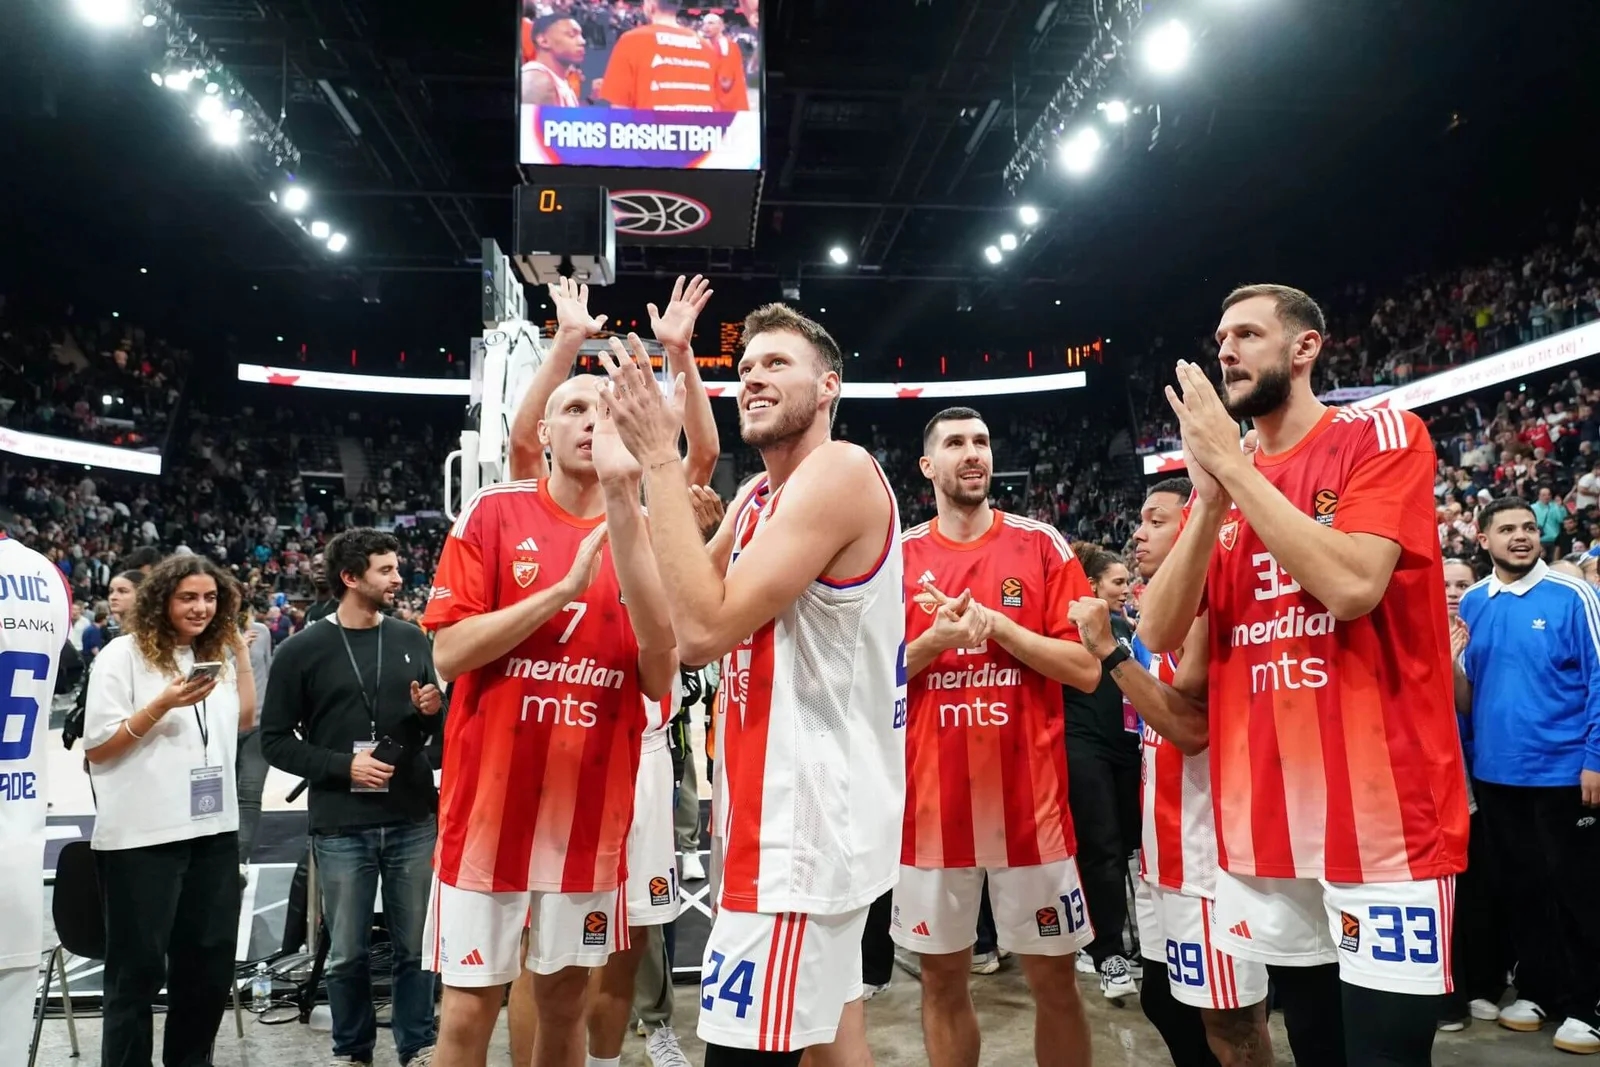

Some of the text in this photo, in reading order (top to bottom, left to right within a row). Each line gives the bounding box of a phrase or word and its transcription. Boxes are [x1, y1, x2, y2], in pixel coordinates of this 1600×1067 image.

[544, 120, 606, 149] PARIS
[557, 601, 588, 644] 7
[505, 656, 625, 689] meridian
[1251, 652, 1328, 693] mts
[520, 692, 598, 728] mts
[939, 697, 1009, 727] mts
[1060, 888, 1085, 933] 13
[1368, 906, 1439, 964] 33
[701, 950, 756, 1018] 24
[1166, 939, 1205, 987] 99
